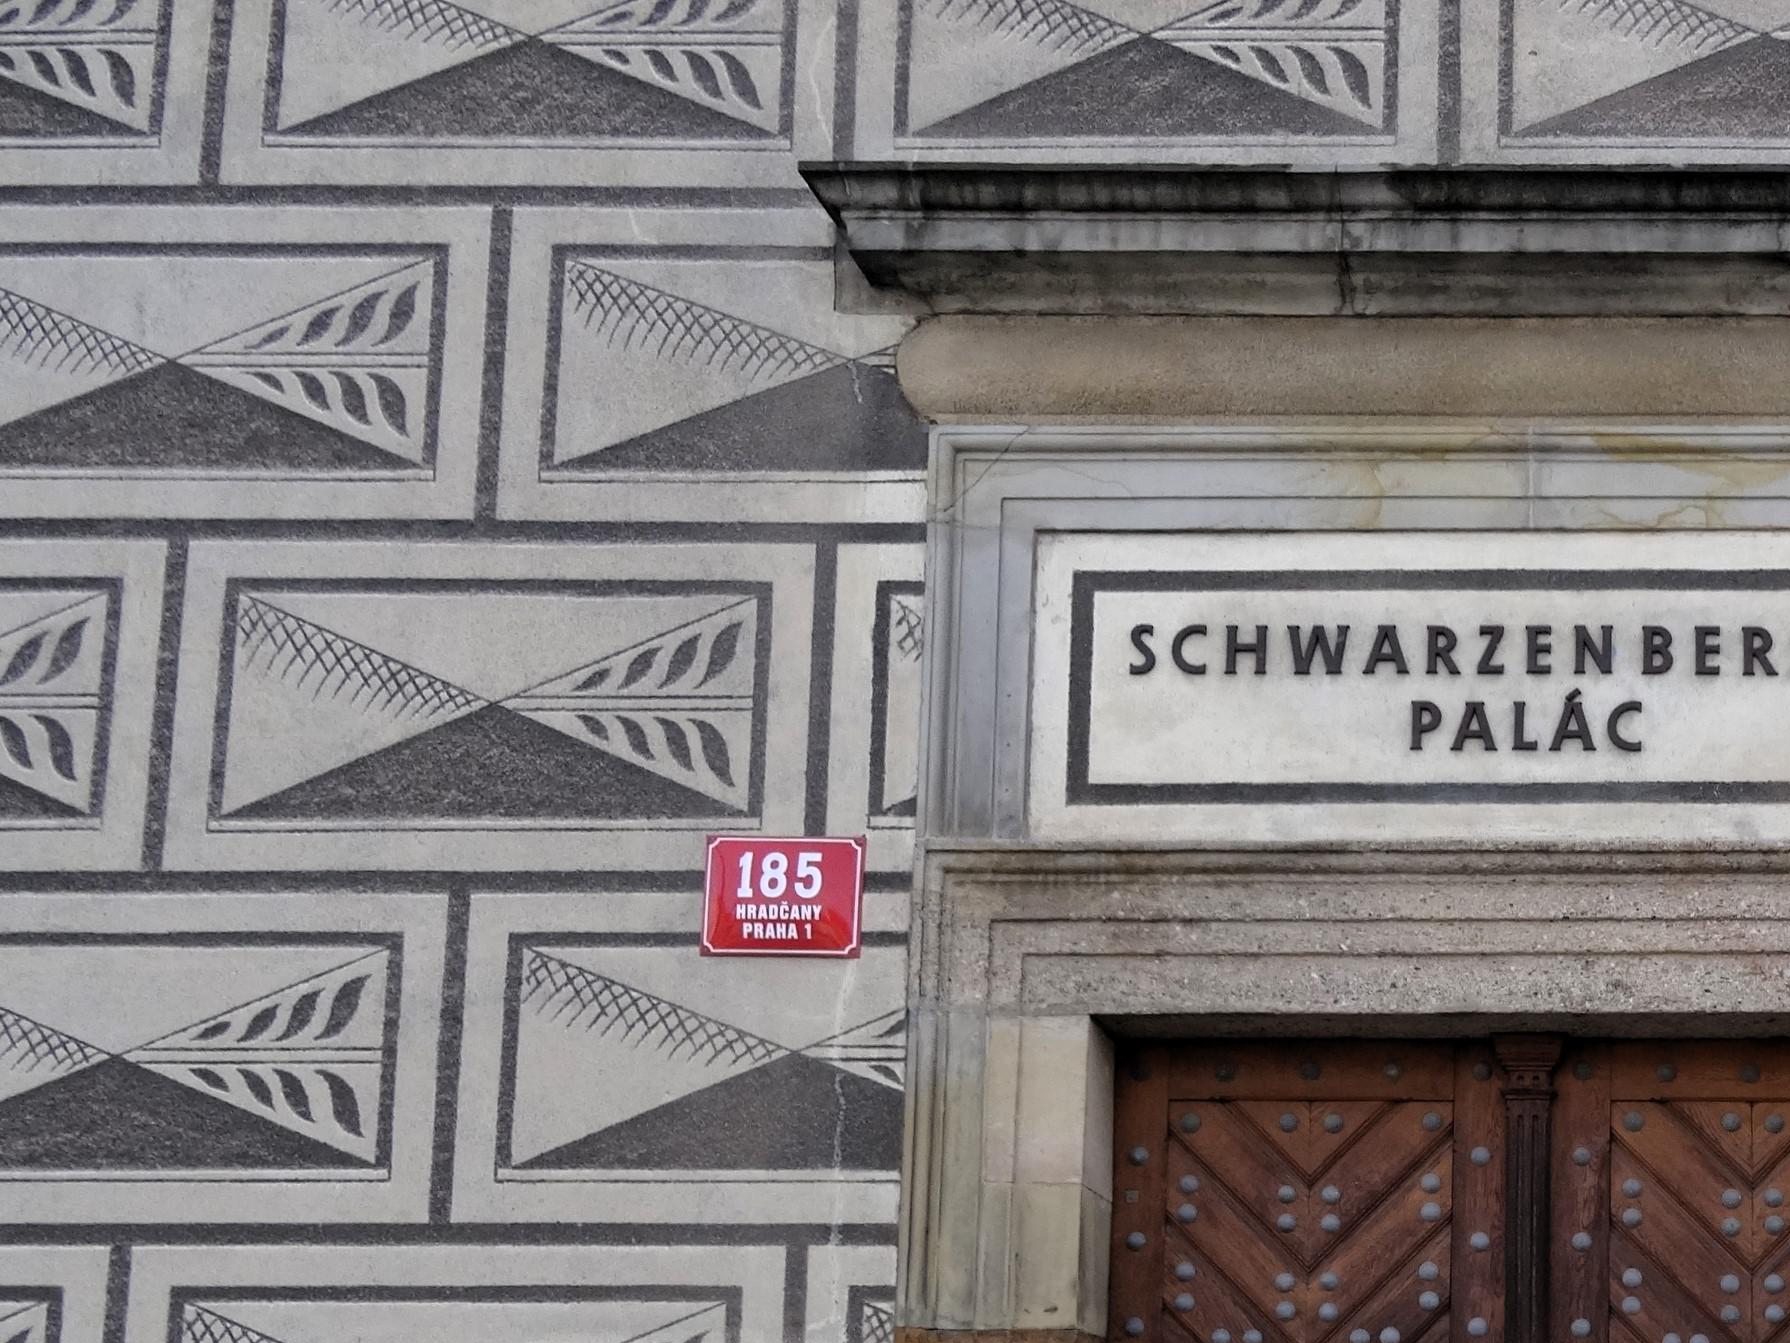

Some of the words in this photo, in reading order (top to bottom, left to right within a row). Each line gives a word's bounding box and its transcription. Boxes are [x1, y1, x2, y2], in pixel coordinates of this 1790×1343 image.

[1409, 688, 1642, 752] PALÁC
[737, 852, 822, 898] 185
[736, 900, 822, 921] HRADČANY
[742, 922, 798, 939] PRAHA
[804, 923, 812, 939] 1
